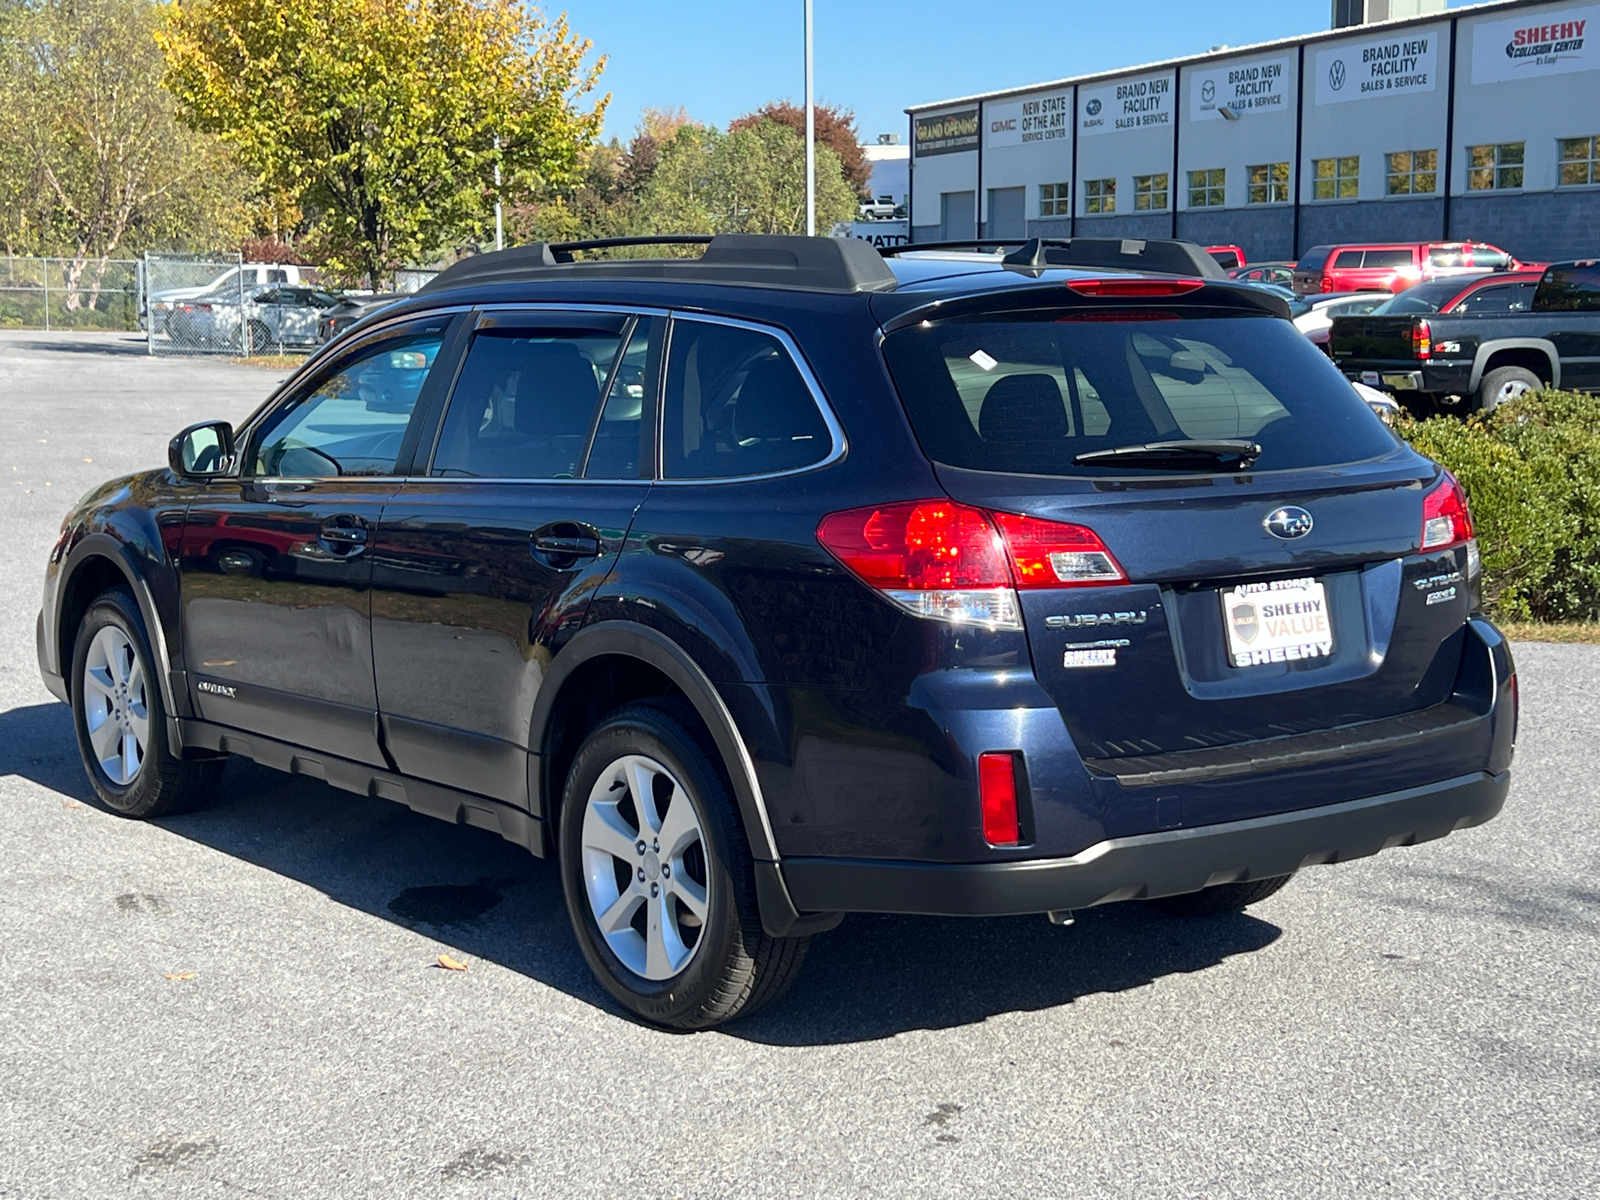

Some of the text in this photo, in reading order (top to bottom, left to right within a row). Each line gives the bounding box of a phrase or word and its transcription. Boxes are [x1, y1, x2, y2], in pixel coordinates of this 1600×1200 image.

[1514, 20, 1586, 46] SHEEHY
[1363, 40, 1428, 62] BRAND NEW
[1514, 38, 1584, 58] COLLISION CENTER
[1229, 64, 1282, 84] BRAND NEW
[1371, 57, 1417, 76] FACILITY
[1117, 79, 1169, 100] BRAND NEW
[1236, 80, 1273, 97] FACILITY
[1361, 74, 1427, 92] SALES & SERVICE
[1022, 97, 1066, 116] NEW STATE
[1124, 96, 1161, 114] FACILITY
[1248, 98, 1252, 107] &
[1255, 95, 1281, 107] SERVICE
[917, 118, 978, 141] GRAND OPENING
[991, 119, 1016, 133] GMC
[1022, 113, 1066, 131] OF THE ART
[1084, 119, 1104, 128] SUBARU
[1116, 112, 1168, 129] SALES & SERVICE
[1022, 128, 1065, 142] SERVICE CENTER
[1234, 577, 1316, 594] AUTO STORES
[1262, 599, 1321, 618] SHEEHY
[1044, 610, 1147, 630] SUBARU
[1265, 615, 1326, 638] VALUE
[1064, 649, 1116, 660] SHEEHY
[1235, 641, 1332, 667] SHEEHY
